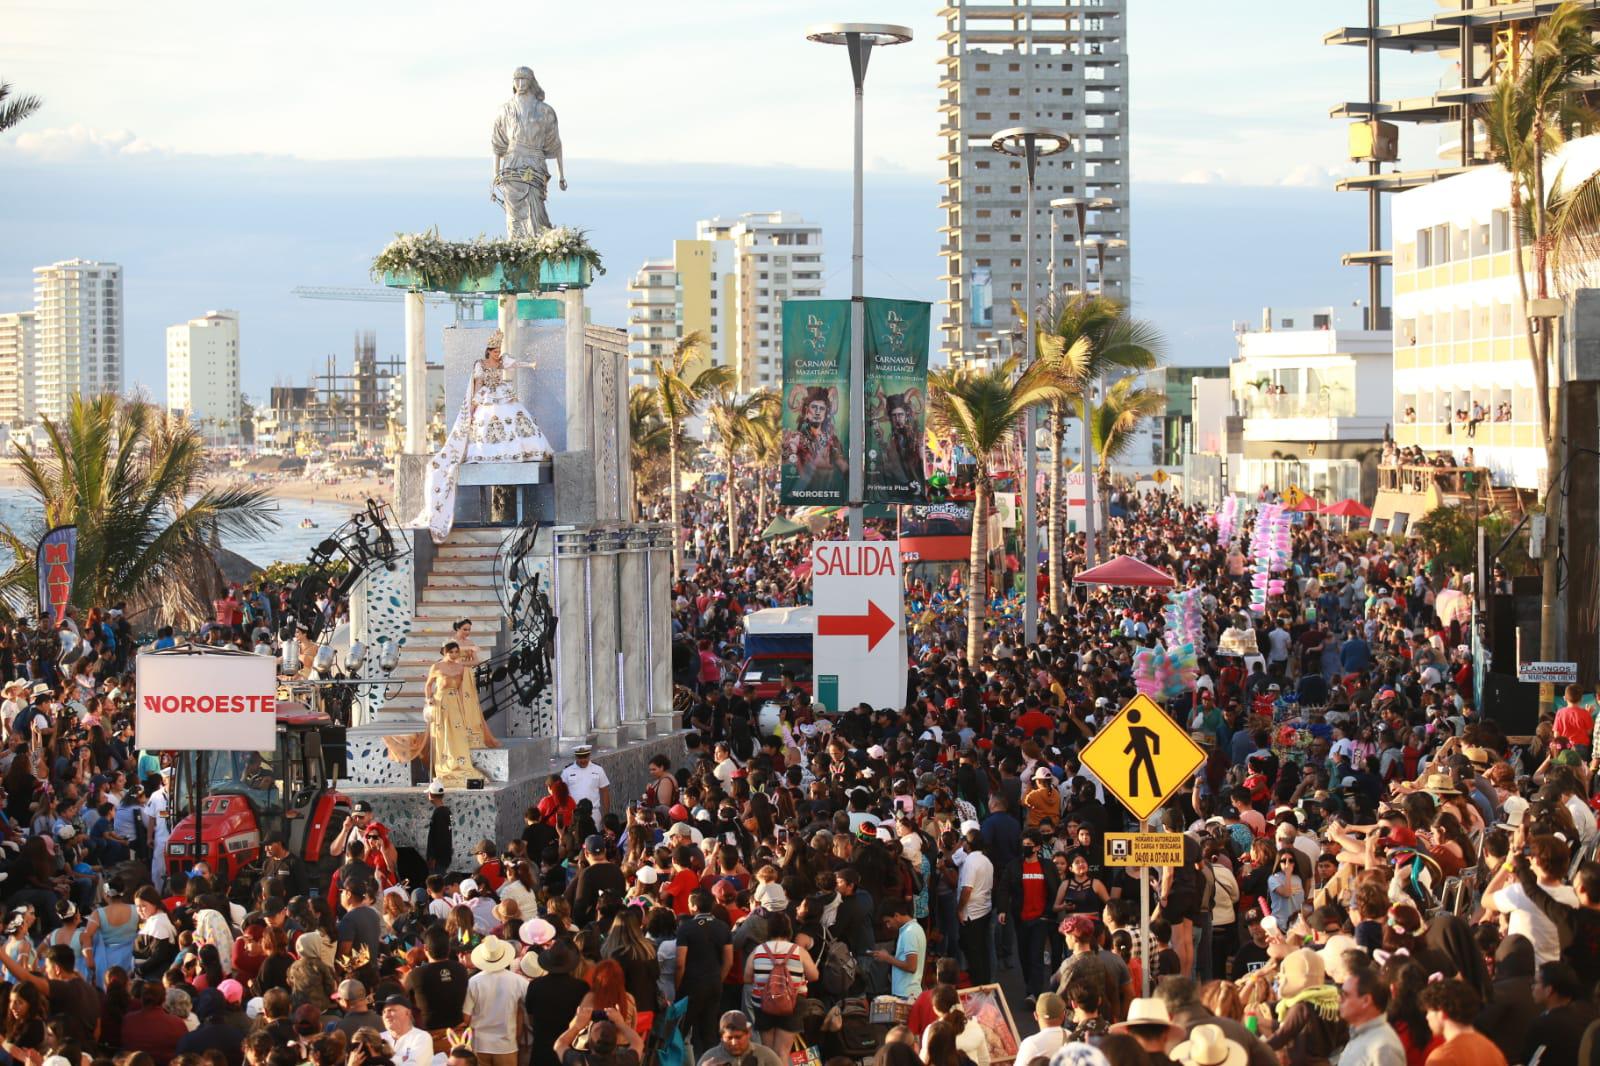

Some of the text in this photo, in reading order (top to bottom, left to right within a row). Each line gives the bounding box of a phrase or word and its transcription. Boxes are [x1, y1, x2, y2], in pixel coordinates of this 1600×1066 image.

[795, 360, 838, 368] CARNAVAL
[874, 355, 916, 365] CARNAVAL
[792, 490, 840, 498] NOROESTE
[816, 546, 896, 576] SALIDA
[144, 695, 275, 714] NOROESTE
[1135, 852, 1149, 863] 04:00
[1150, 852, 1154, 863] A
[1155, 852, 1169, 863] 07:00
